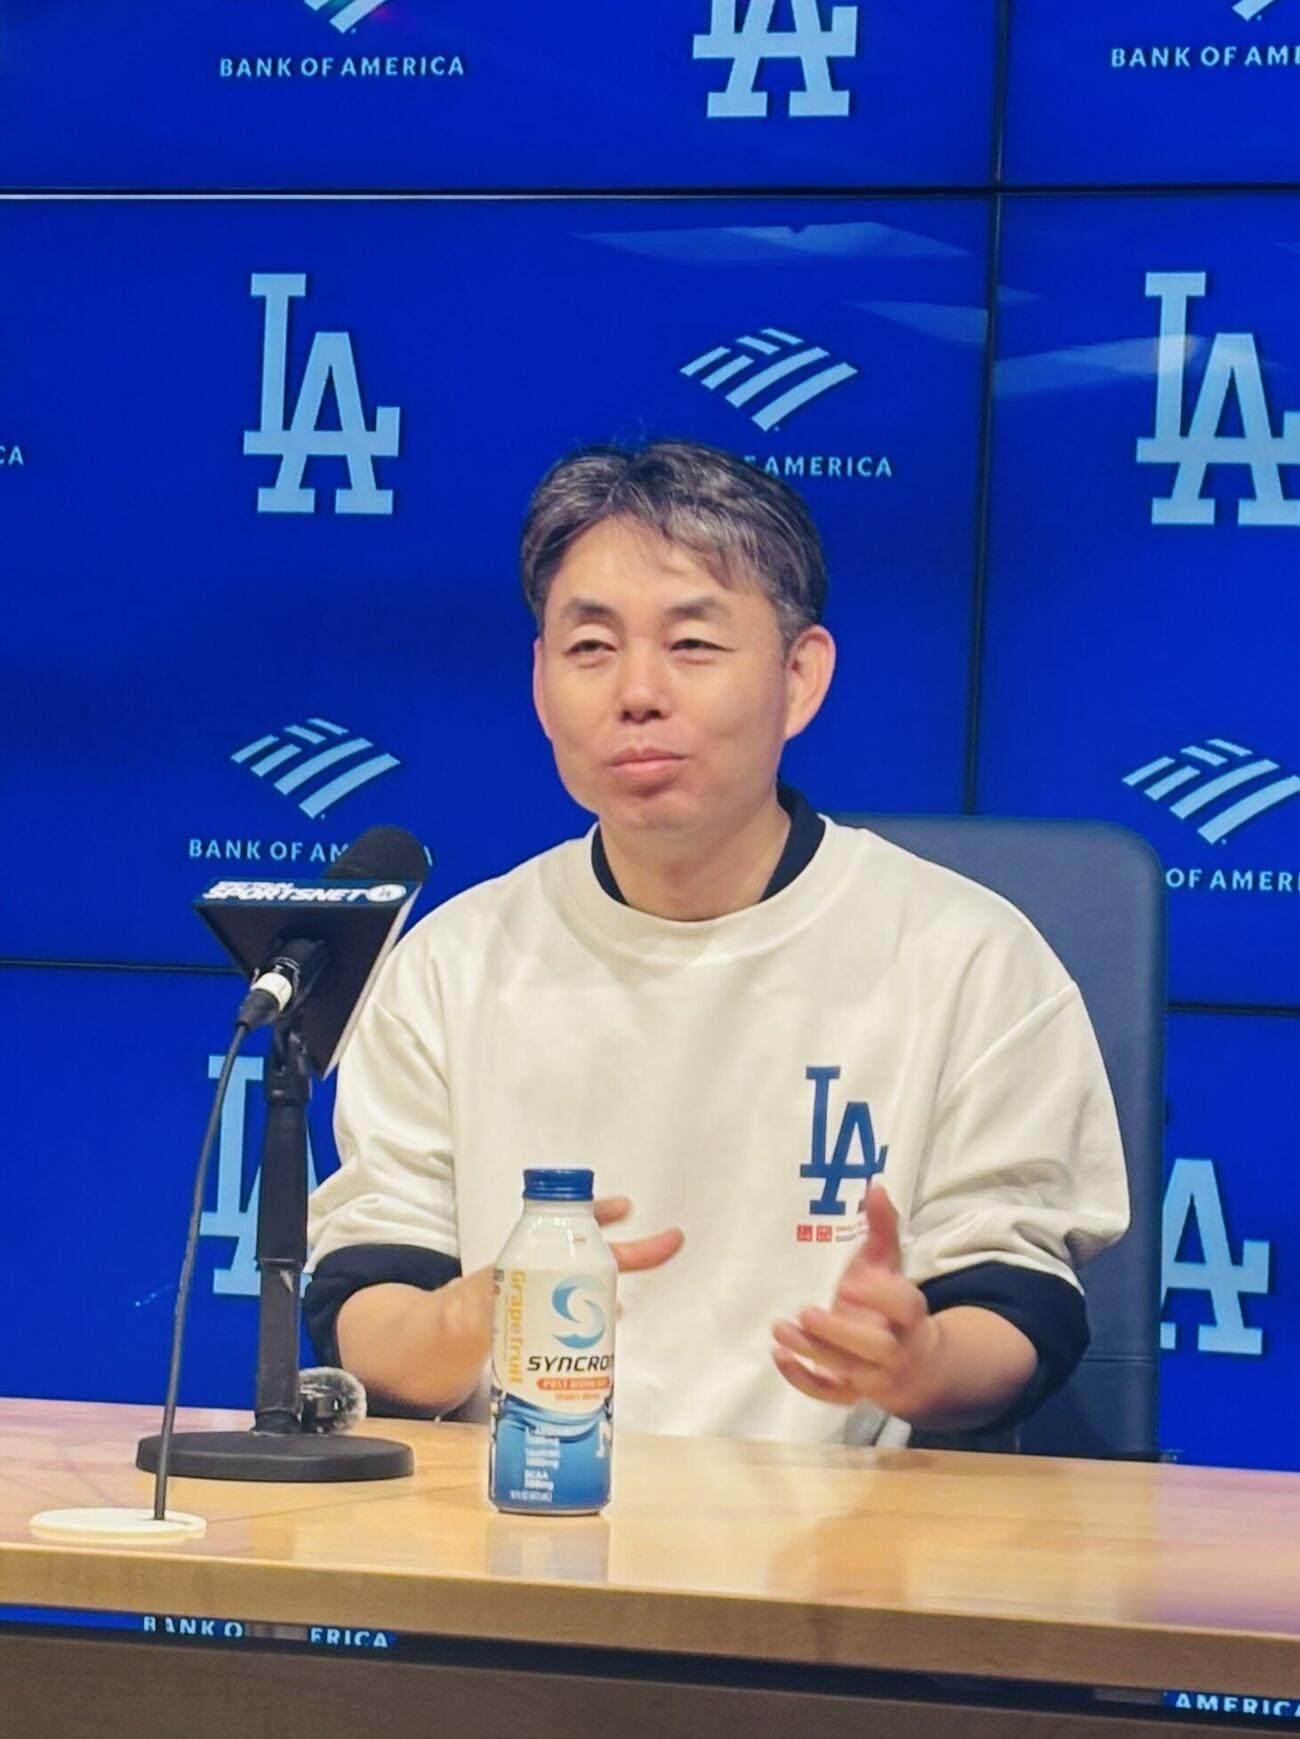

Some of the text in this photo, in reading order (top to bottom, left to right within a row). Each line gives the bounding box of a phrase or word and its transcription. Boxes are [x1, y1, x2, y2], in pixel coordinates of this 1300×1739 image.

[219, 56, 464, 78] BANK OF AMERICA
[1111, 46, 1190, 68] BANK
[1200, 46, 1237, 67] OF
[243, 273, 400, 514] LA
[1136, 272, 1300, 526] LA
[764, 455, 892, 478] AMERICA
[189, 839, 261, 861] BANK
[269, 841, 303, 861] OF
[1166, 868, 1202, 889] OF
[800, 1066, 889, 1215] LA
[311, 1627, 388, 1648] ERICA
